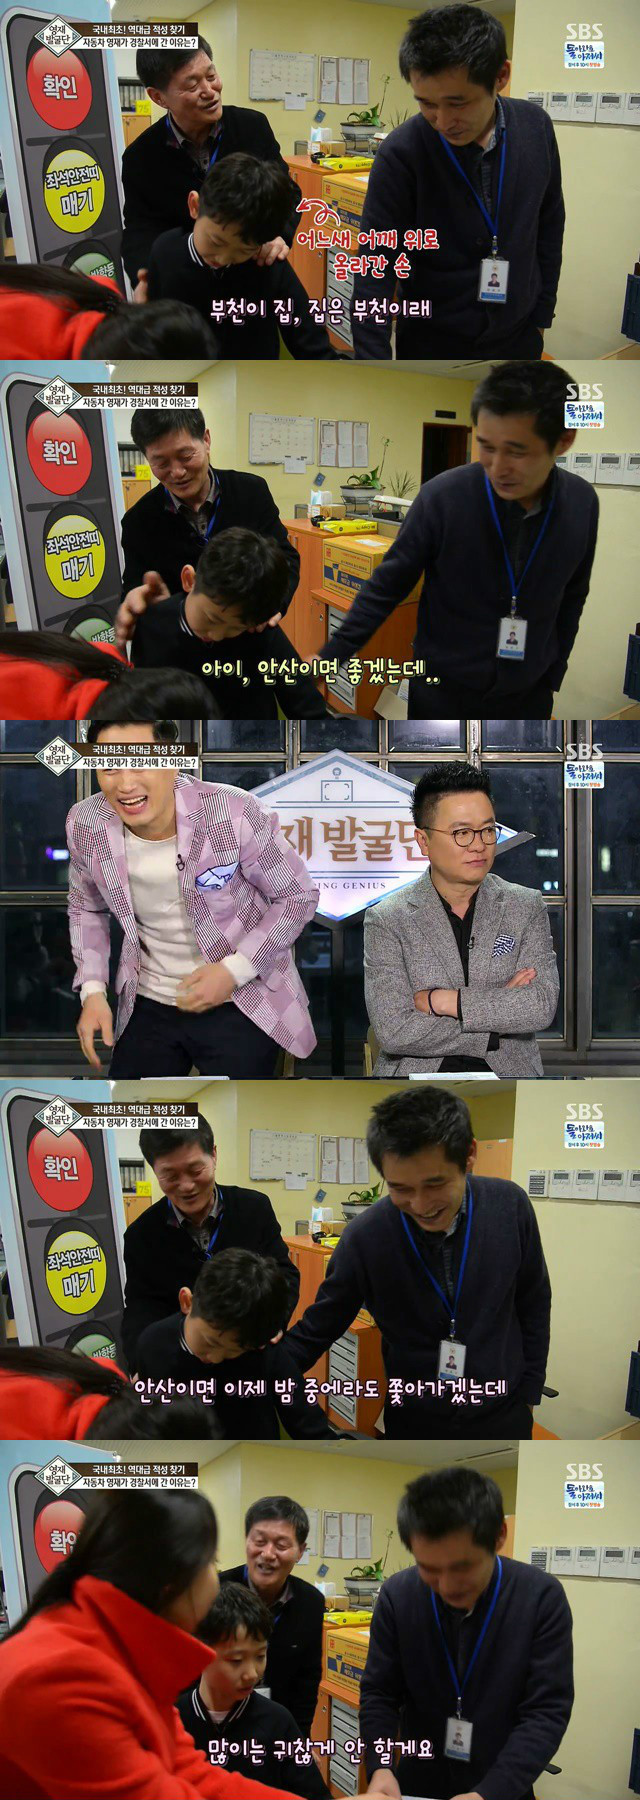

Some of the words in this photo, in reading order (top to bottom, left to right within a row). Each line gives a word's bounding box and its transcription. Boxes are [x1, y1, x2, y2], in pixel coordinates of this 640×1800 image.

[43, 74, 78, 100] 확인
[138, 105, 150, 113] 75
[46, 165, 100, 190] 좌석안전띠
[61, 189, 94, 216] 매기
[281, 816, 313, 861] 재
[44, 1155, 79, 1181] 확인
[138, 1186, 150, 1194] 75
[47, 1246, 102, 1271] 좌석안전띠
[62, 1269, 96, 1298] 매기
